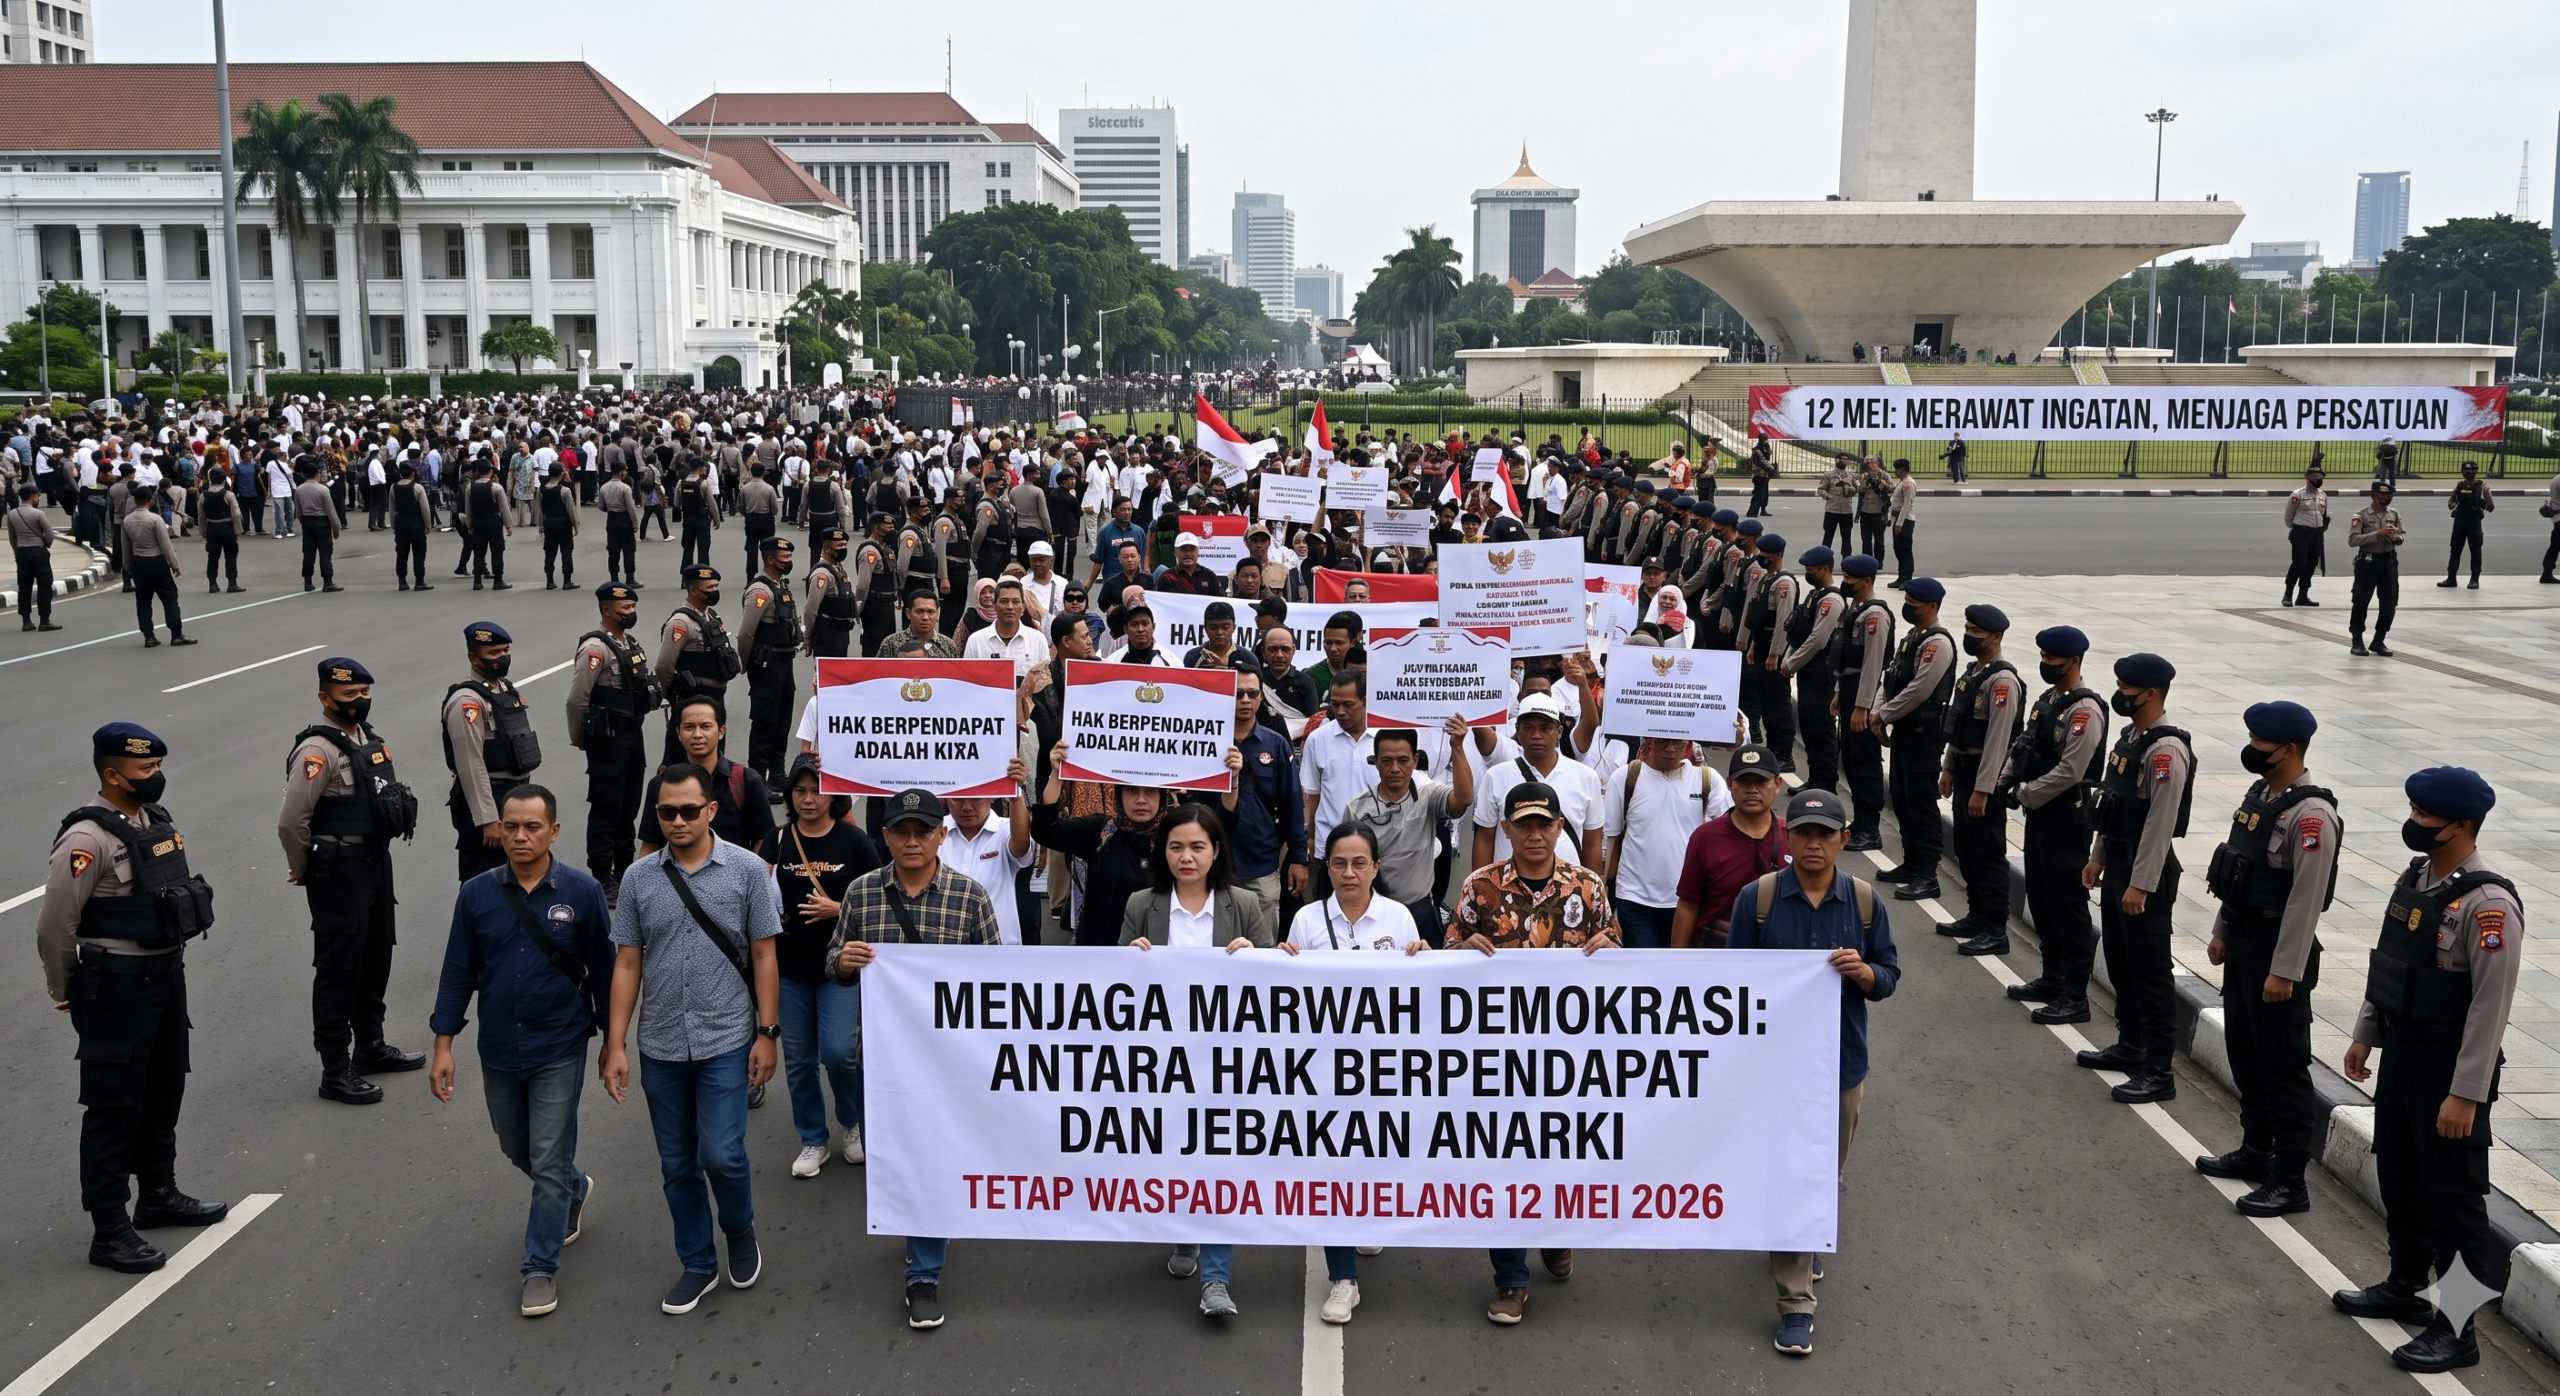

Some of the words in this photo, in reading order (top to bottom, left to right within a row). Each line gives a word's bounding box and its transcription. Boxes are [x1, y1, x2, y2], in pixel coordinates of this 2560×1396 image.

[1805, 398, 1834, 429] 12
[1843, 398, 1896, 429] MEI:
[1906, 398, 2034, 430] MERAWAT
[2042, 398, 2158, 433] INGATAN,
[2167, 398, 2288, 430] MENJAGA
[2296, 398, 2449, 430] PERSATUAN
[828, 715, 867, 734] HAK
[871, 716, 1005, 736] BERPENDAPAT
[1071, 710, 1105, 729] HAK
[1108, 713, 1225, 736] BERPENDAPAT
[854, 740, 929, 760] ADALAH
[1075, 732, 1140, 752] ADALAH
[1144, 737, 1178, 755] HAK
[1182, 739, 1218, 758] KITA
[934, 981, 1173, 1032] MENJAGA
[1189, 984, 1420, 1035] MARWAH
[1440, 985, 1767, 1036] DEMOKRASI:
[989, 1043, 1196, 1094] ANTARA
[1212, 1046, 1318, 1096] HAK
[1334, 1048, 1710, 1098] BERPENDAPAT
[1060, 1105, 1163, 1155] DAN
[1180, 1107, 1410, 1158] JEBAKAN
[1427, 1111, 1624, 1161] ANARKI
[963, 1175, 1073, 1210] TETAP
[1086, 1178, 1263, 1215] WASPADA
[1276, 1181, 1494, 1219] MENJELANG
[1506, 1183, 1541, 1219] 12
[1556, 1184, 1619, 1219] MEI
[1632, 1183, 1724, 1219] 2026
